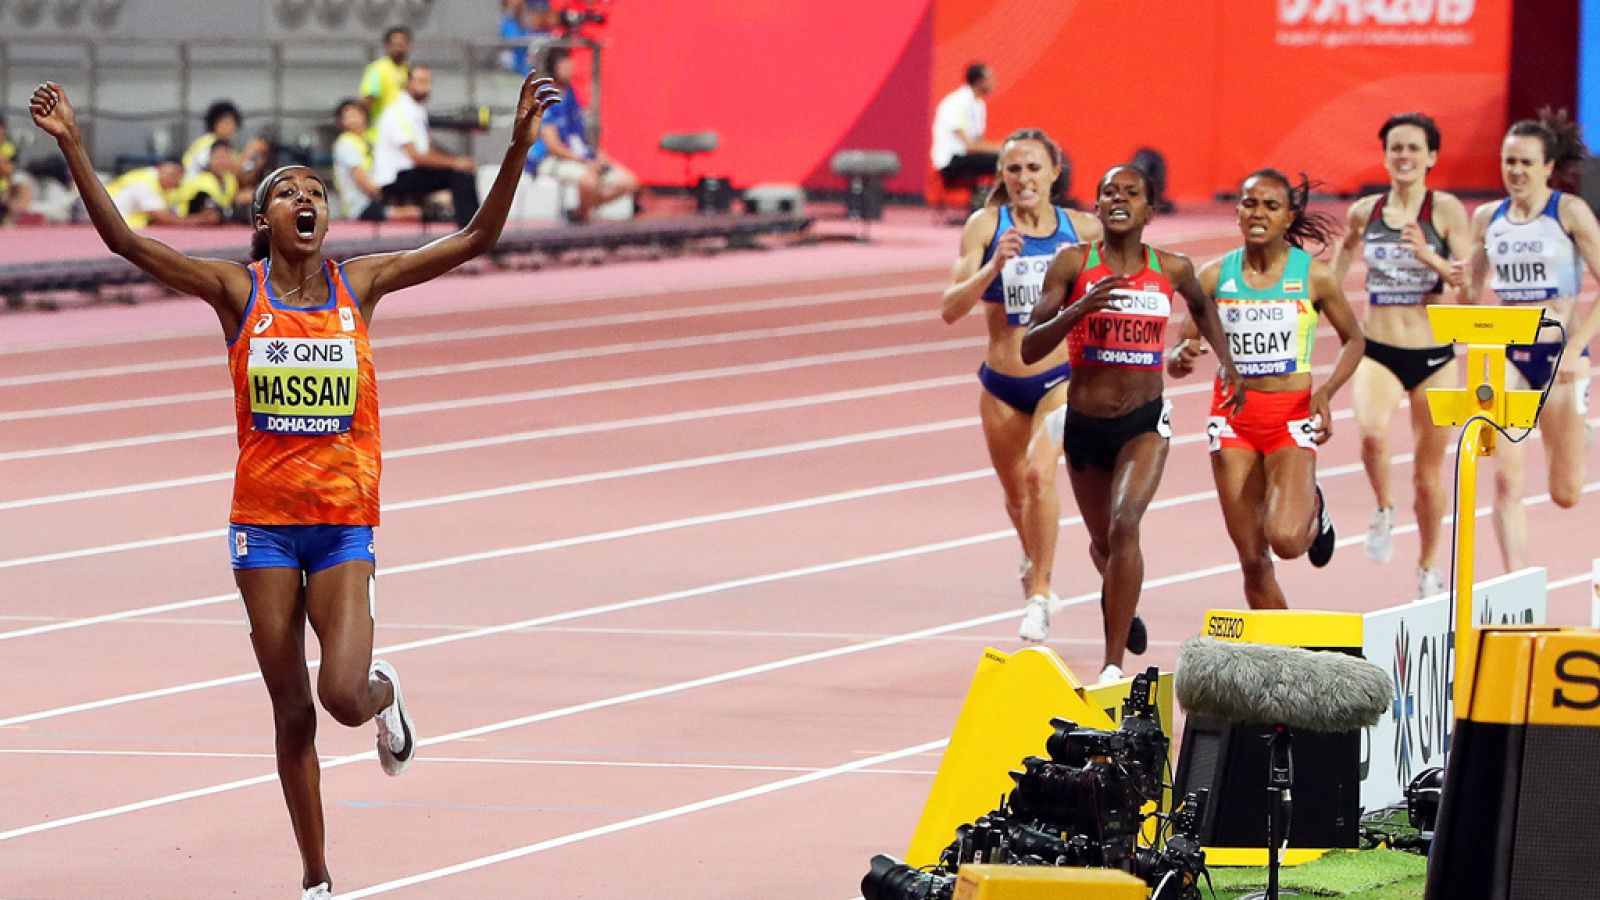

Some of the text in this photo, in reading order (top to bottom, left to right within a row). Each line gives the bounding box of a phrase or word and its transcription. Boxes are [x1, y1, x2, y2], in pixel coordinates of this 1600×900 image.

[1496, 262, 1546, 283] MUIR
[1007, 283, 1041, 307] HOU
[1245, 306, 1284, 321] QNB
[1088, 316, 1164, 344] KIPYEGON
[293, 343, 344, 362] QNB
[1097, 349, 1154, 365] DOHA2019
[1237, 360, 1287, 375] OHA2019
[253, 374, 351, 407] HASSAN
[268, 416, 340, 433] DOHA2019
[1208, 615, 1245, 639] SEIKO
